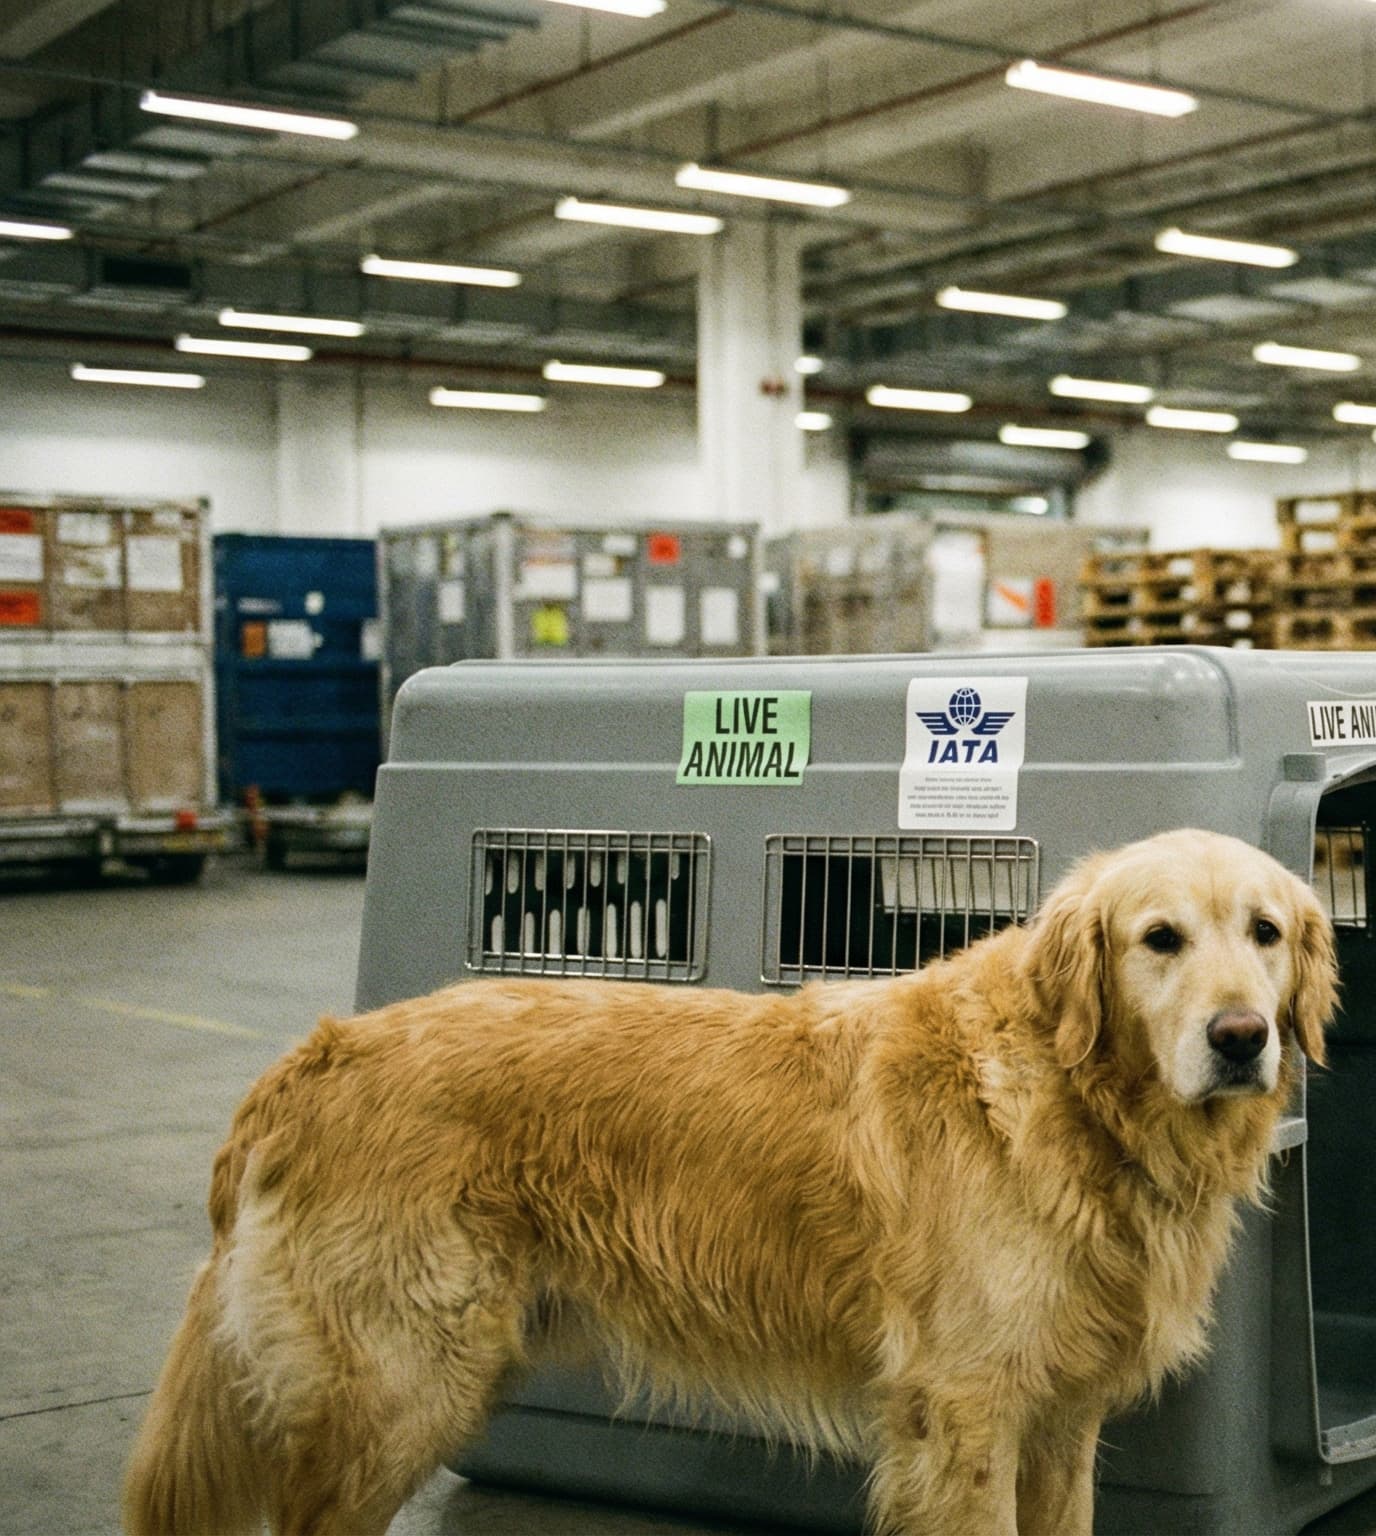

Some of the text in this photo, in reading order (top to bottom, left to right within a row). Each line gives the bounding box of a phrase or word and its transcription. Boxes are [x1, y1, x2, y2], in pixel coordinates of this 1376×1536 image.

[715, 697, 778, 735] LIVE
[1310, 706, 1346, 740] LIVE
[683, 741, 800, 778] ANIMAL
[927, 740, 999, 764] IATA
